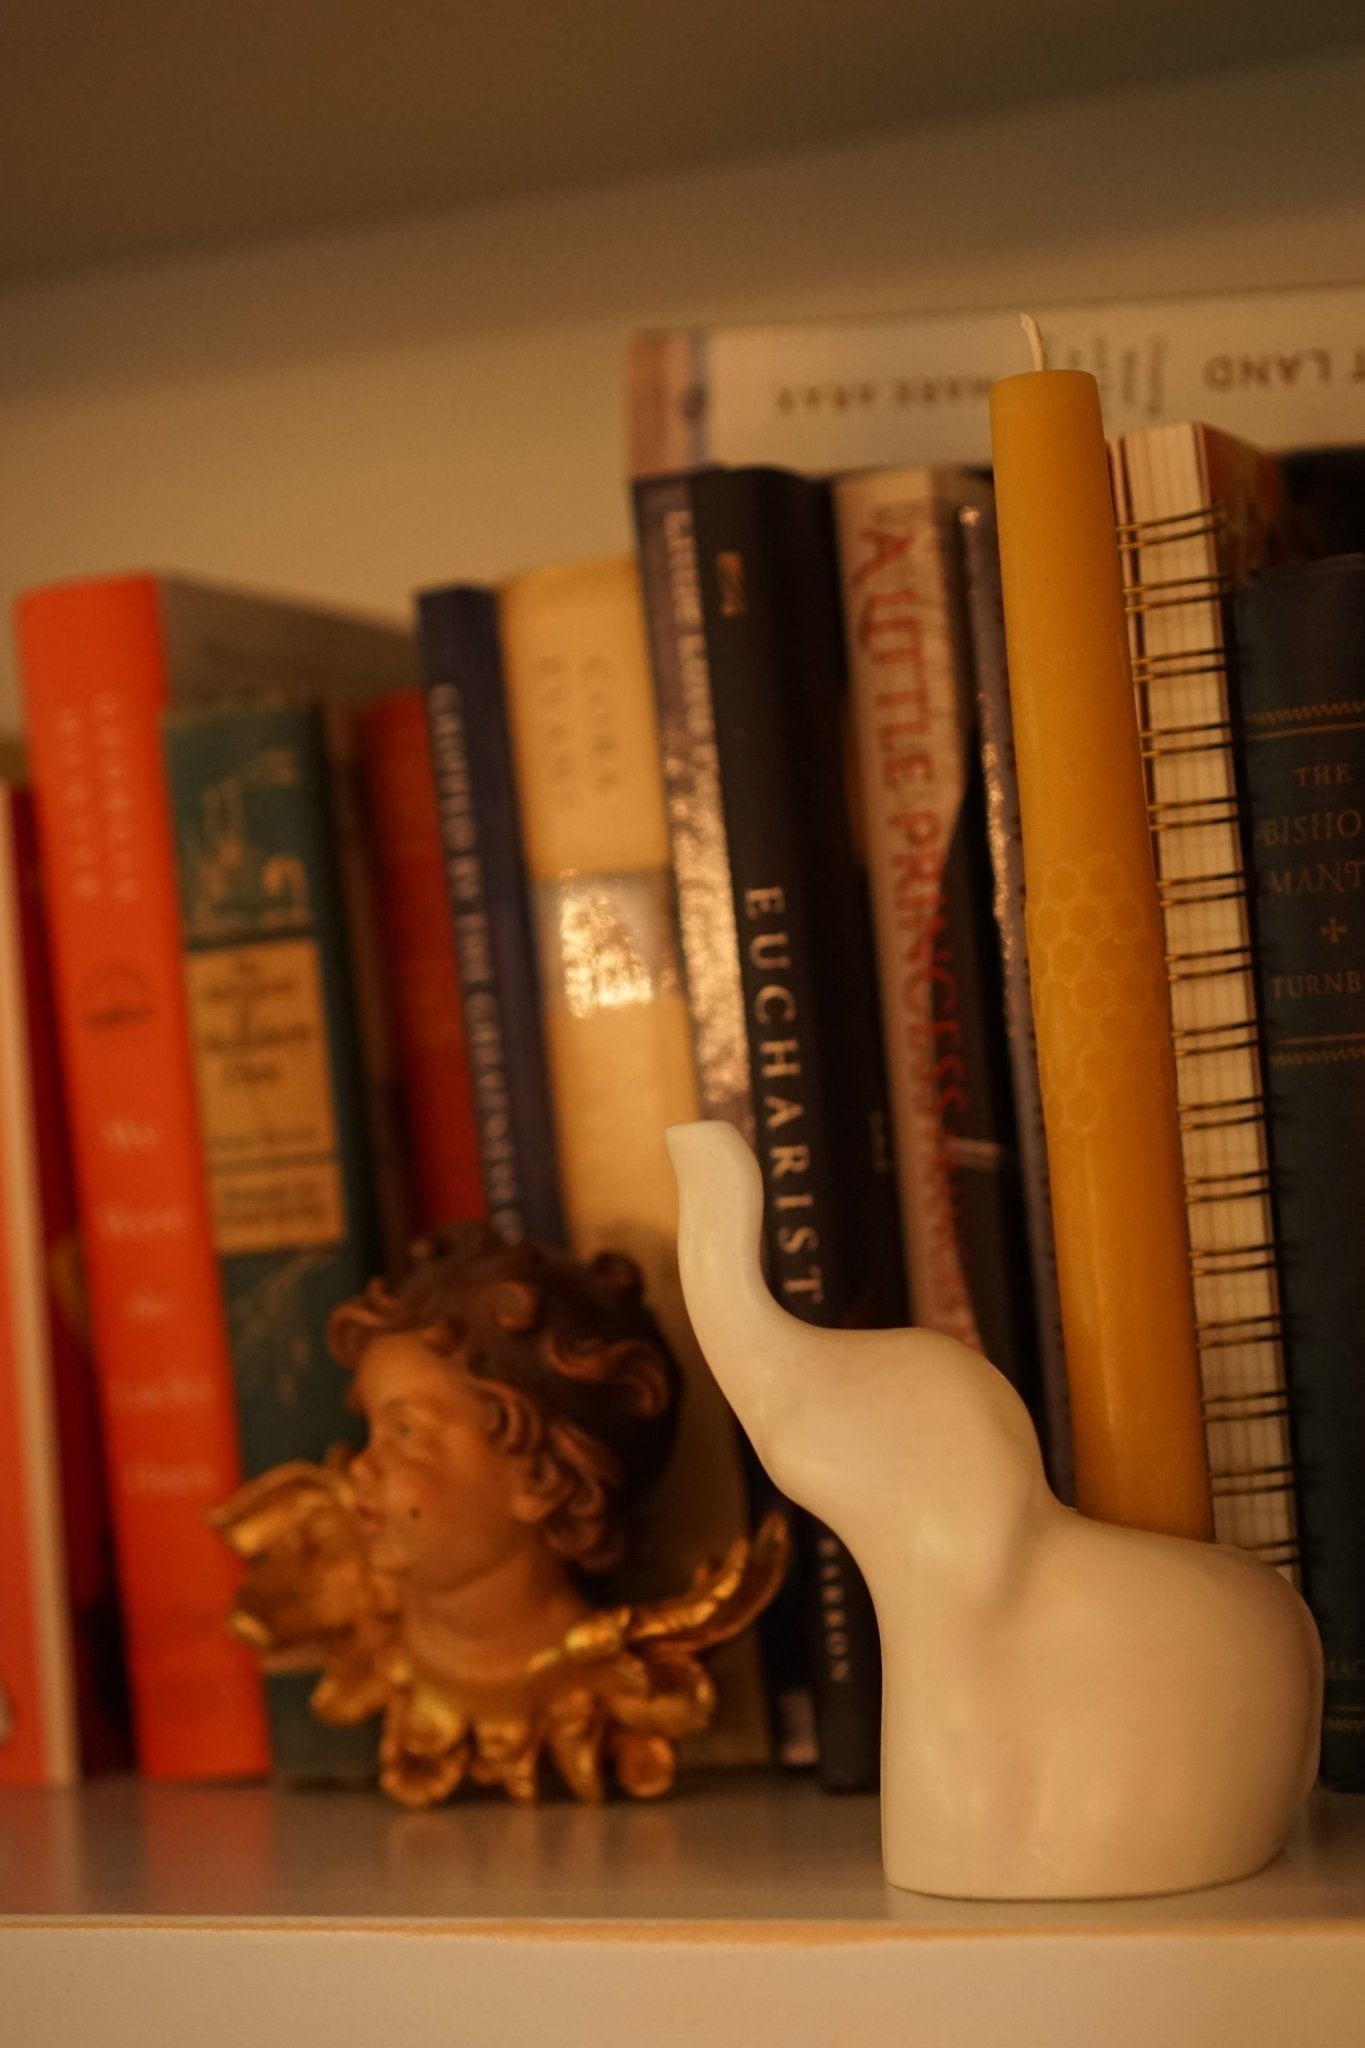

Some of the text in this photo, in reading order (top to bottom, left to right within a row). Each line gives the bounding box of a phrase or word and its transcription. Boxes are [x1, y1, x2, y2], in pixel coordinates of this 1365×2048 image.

[1201, 347, 1332, 394] LAND
[851, 524, 914, 590] A
[860, 587, 935, 790] LITTLE
[1294, 762, 1352, 789] THE
[1271, 969, 1365, 1000] TURNB
[744, 885, 825, 1306] EUCHARIST
